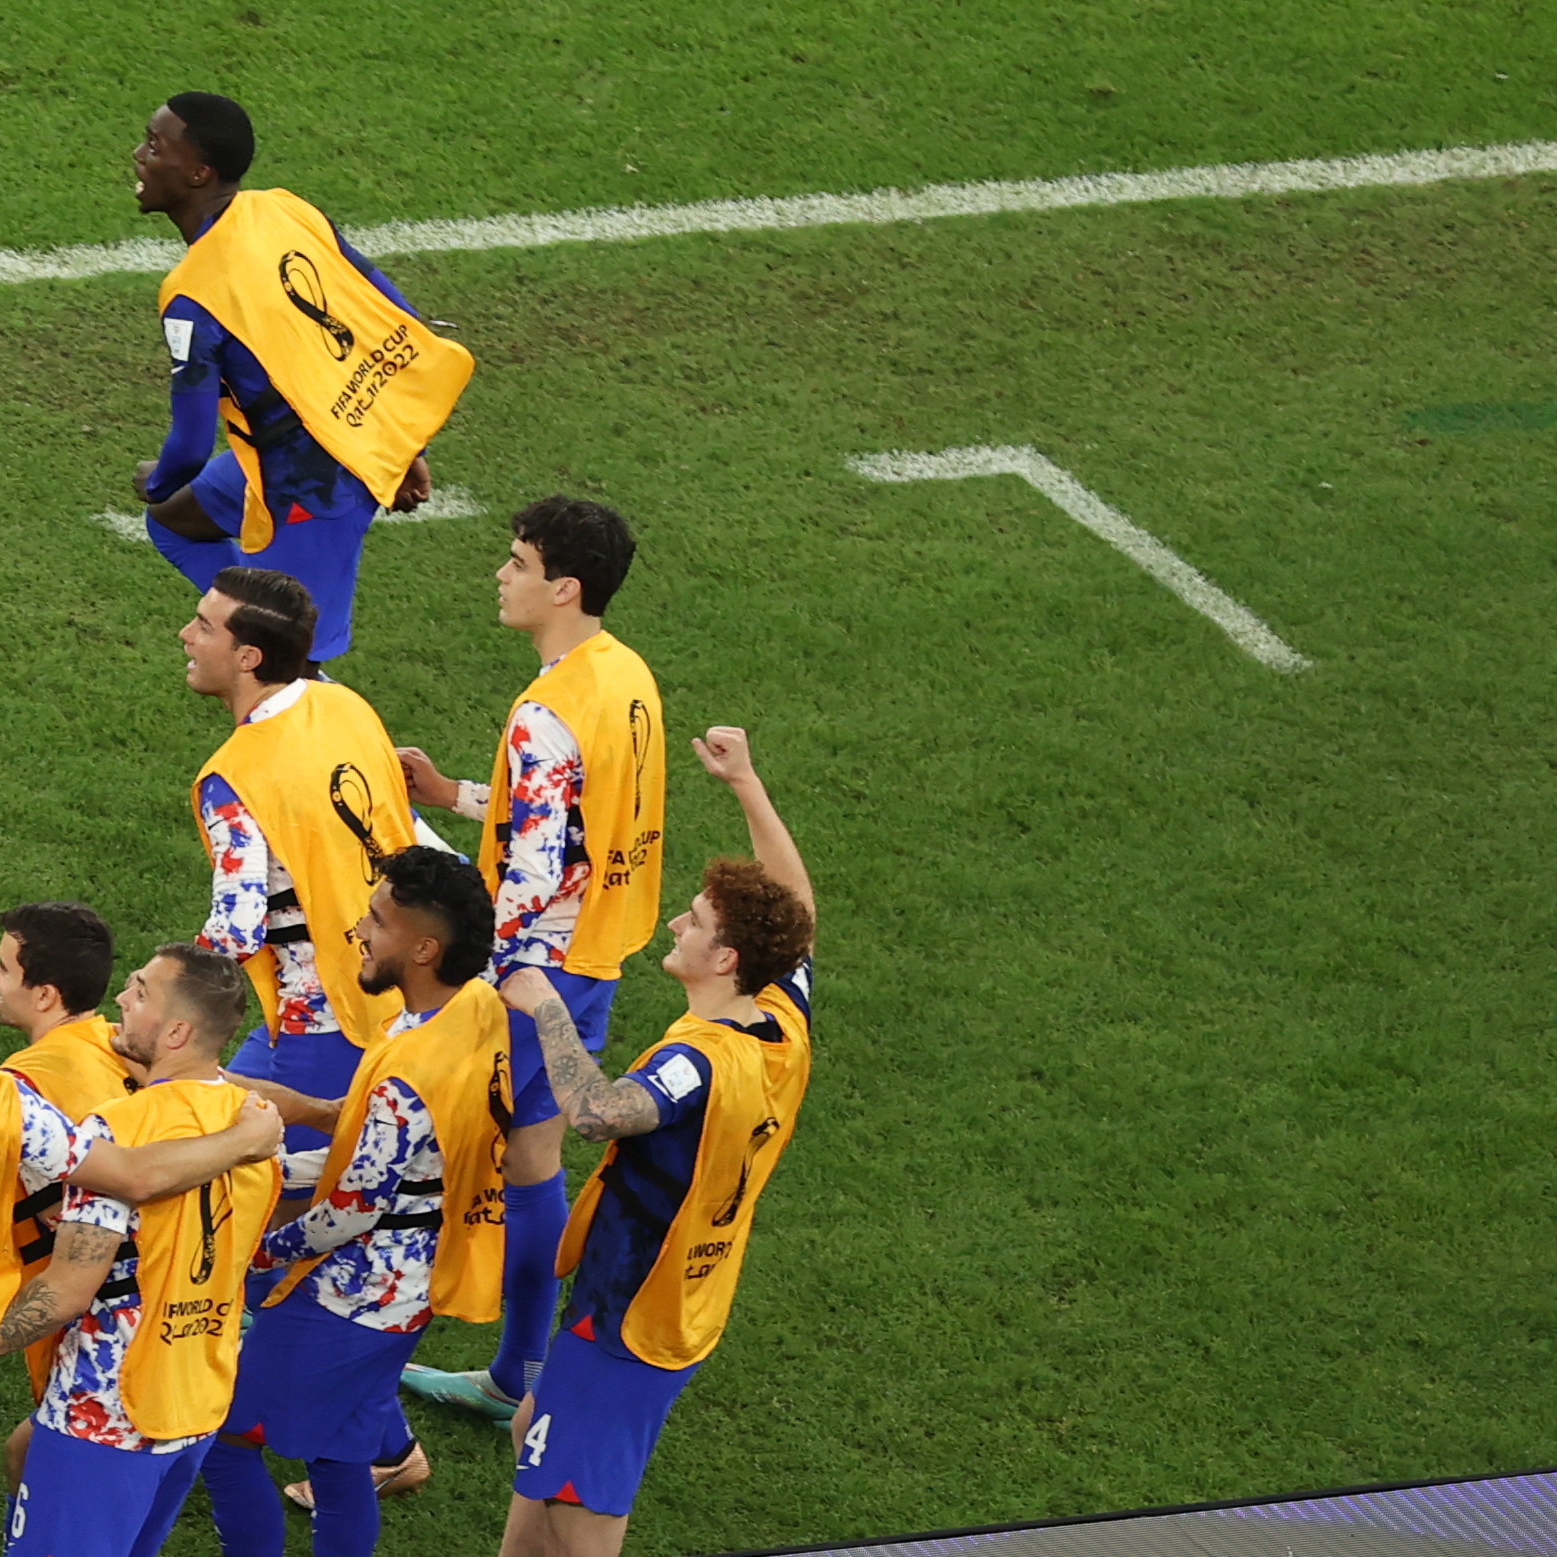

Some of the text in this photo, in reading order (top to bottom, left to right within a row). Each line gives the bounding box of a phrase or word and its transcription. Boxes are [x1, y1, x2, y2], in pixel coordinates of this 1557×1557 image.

[330, 324, 409, 420] FIFA WORLD CUP
[524, 1413, 552, 1467] 4
